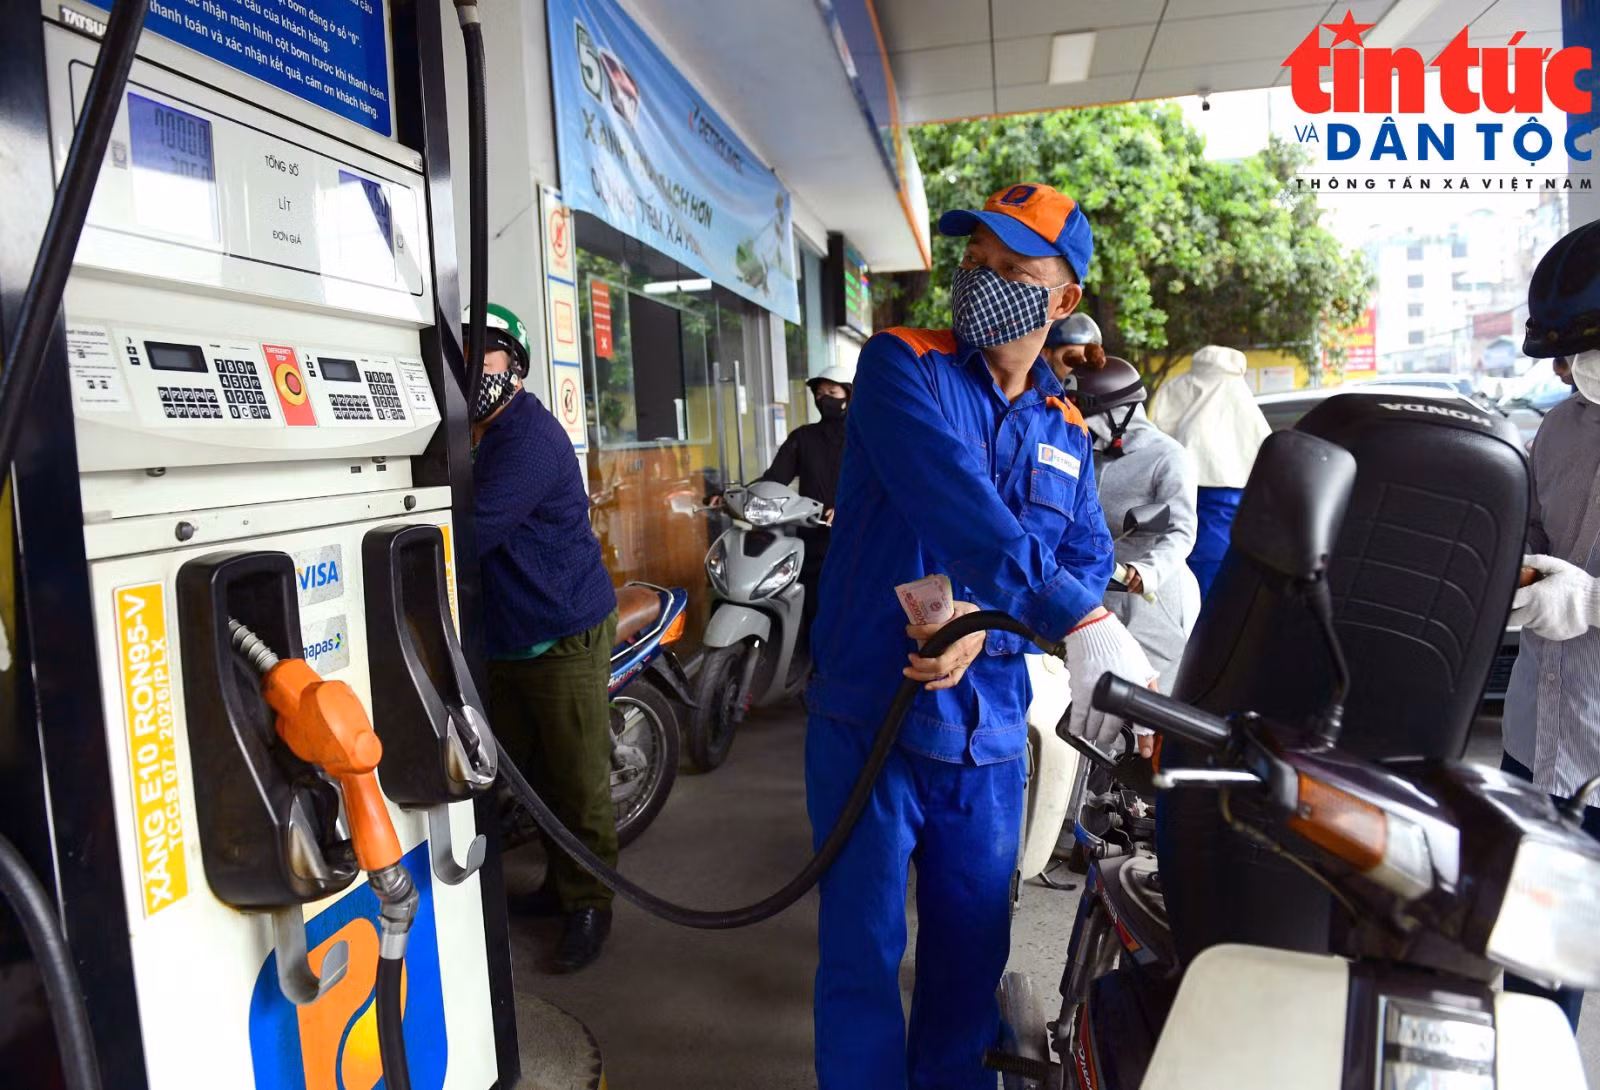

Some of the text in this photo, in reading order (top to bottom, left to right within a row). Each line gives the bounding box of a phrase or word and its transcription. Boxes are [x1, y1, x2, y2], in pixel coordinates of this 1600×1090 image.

[62, 7, 107, 37] TATSU
[263, 8, 280, 25] của
[281, 15, 307, 39] khách
[308, 29, 331, 53] hàng.
[308, 9, 328, 32] đang
[337, 25, 347, 40] số
[149, 0, 182, 25] thanh
[184, 15, 208, 37] toán
[210, 28, 223, 44] và
[225, 36, 242, 53] xác
[244, 45, 268, 66] nhận
[269, 57, 284, 73] kết
[336, 87, 359, 109] khách
[359, 99, 379, 119] hàng.
[202, 0, 228, 21] nhận
[230, 14, 251, 33] màn
[252, 23, 274, 45] hình
[275, 37, 289, 53] cột
[290, 42, 310, 63] bơm
[311, 54, 334, 75] trước
[335, 65, 347, 82] khi
[348, 72, 369, 93] thanh
[1377, 403, 1493, 427] HONDA
[296, 561, 339, 590] VISA
[123, 593, 174, 908] XĂNG E10 RON95-V
[161, 759, 177, 784] 07
[164, 785, 183, 852] TCCS
